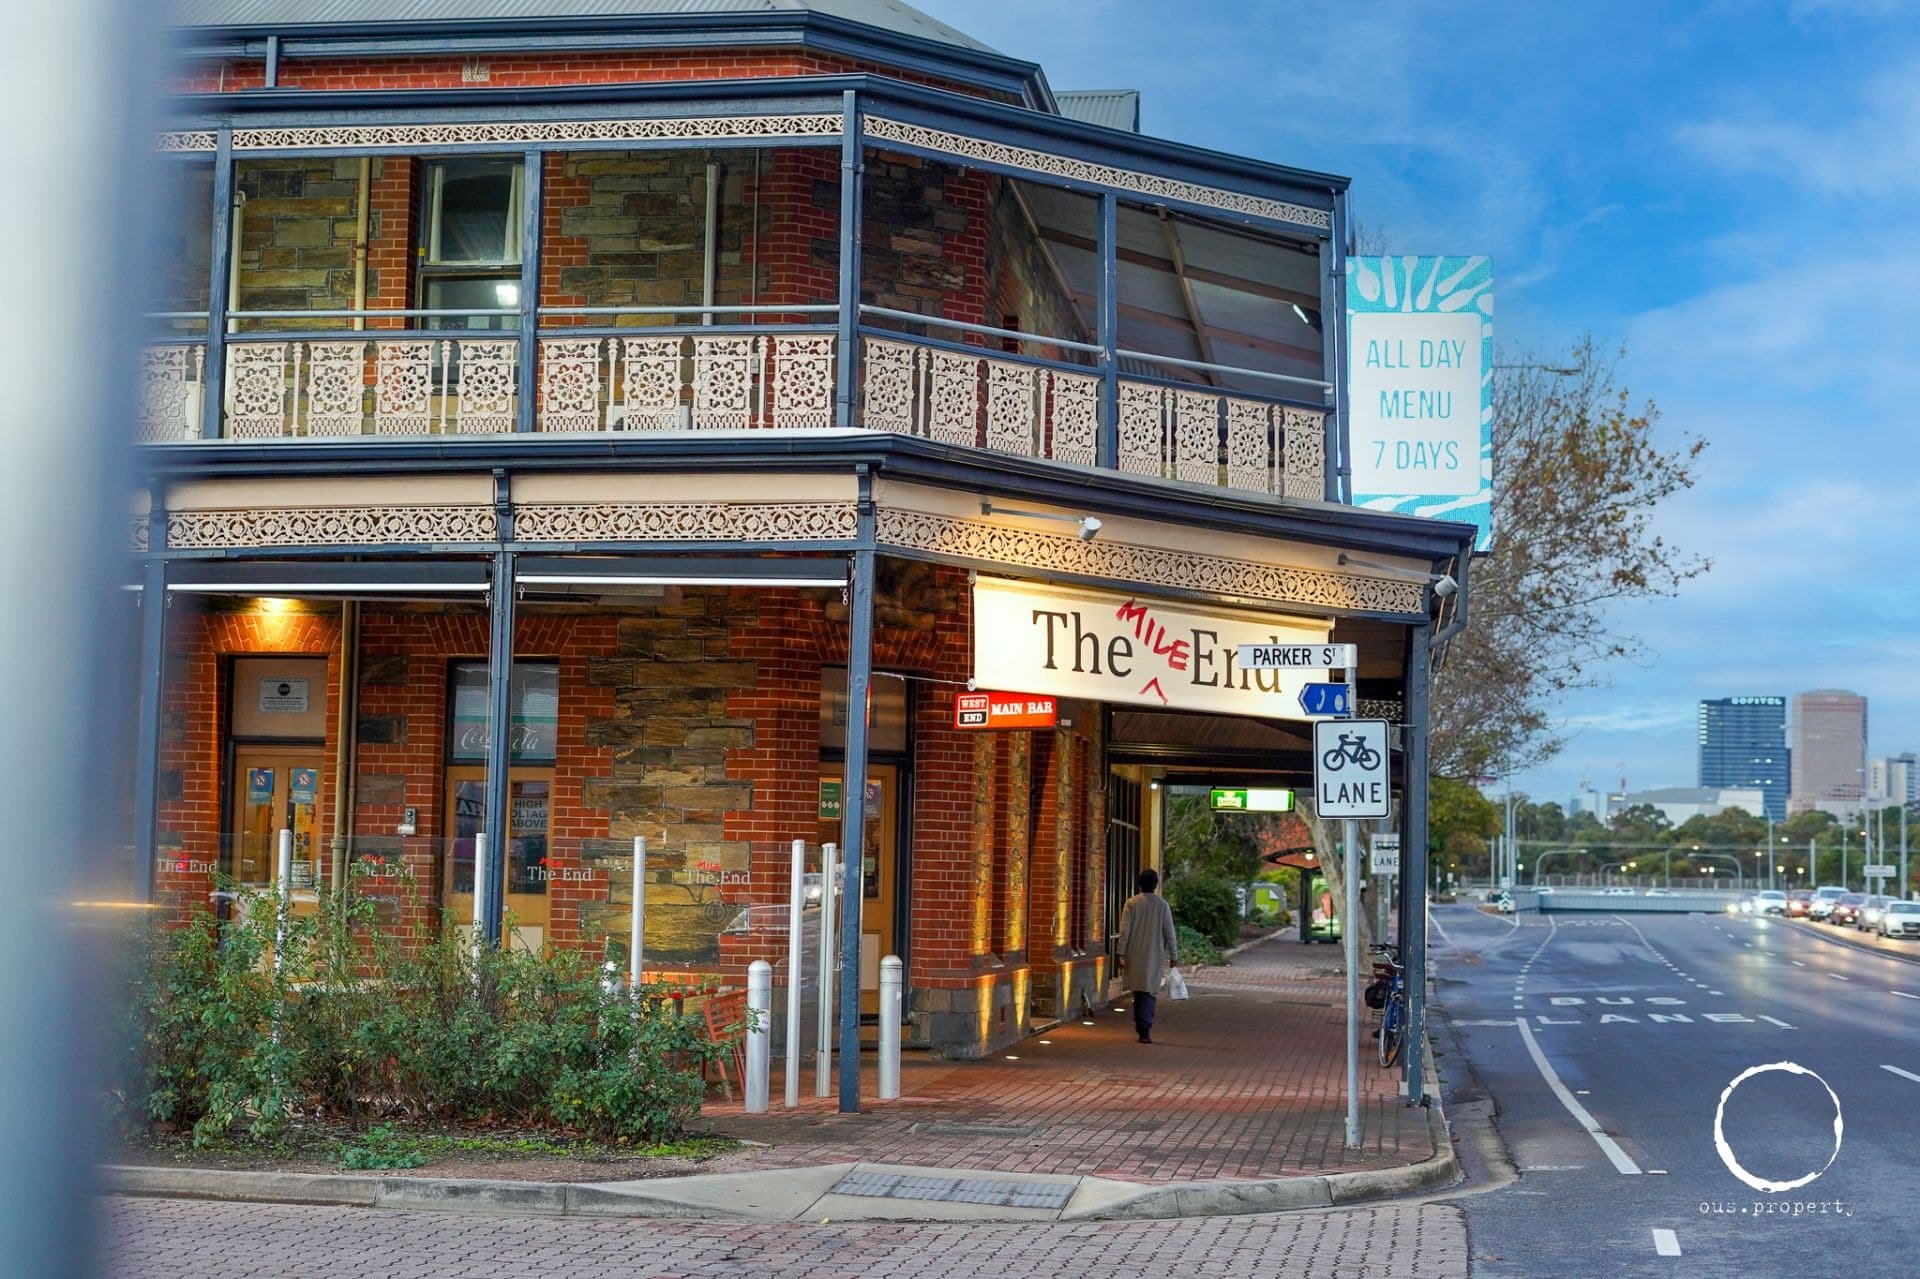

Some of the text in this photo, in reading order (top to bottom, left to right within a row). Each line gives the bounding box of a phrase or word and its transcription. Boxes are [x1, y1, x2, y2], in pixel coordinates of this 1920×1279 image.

[1366, 339, 1466, 368] ALL DAY
[1379, 390, 1452, 419] MENU
[1372, 440, 1459, 470] 7 DAYS
[1032, 609, 1134, 678] The
[1115, 597, 1192, 672] MILE
[1253, 647, 1313, 666] PARKER
[961, 698, 986, 709] WEST
[991, 701, 1053, 715] MAIN BAR
[963, 713, 983, 723] END
[1323, 782, 1382, 804] LANE
[514, 800, 543, 808] HIGH
[1374, 857, 1400, 867] LANE
[527, 866, 592, 882] The End
[685, 868, 751, 885] The End
[1550, 996, 1687, 1006] BUS
[1536, 1013, 1756, 1024] LANE
